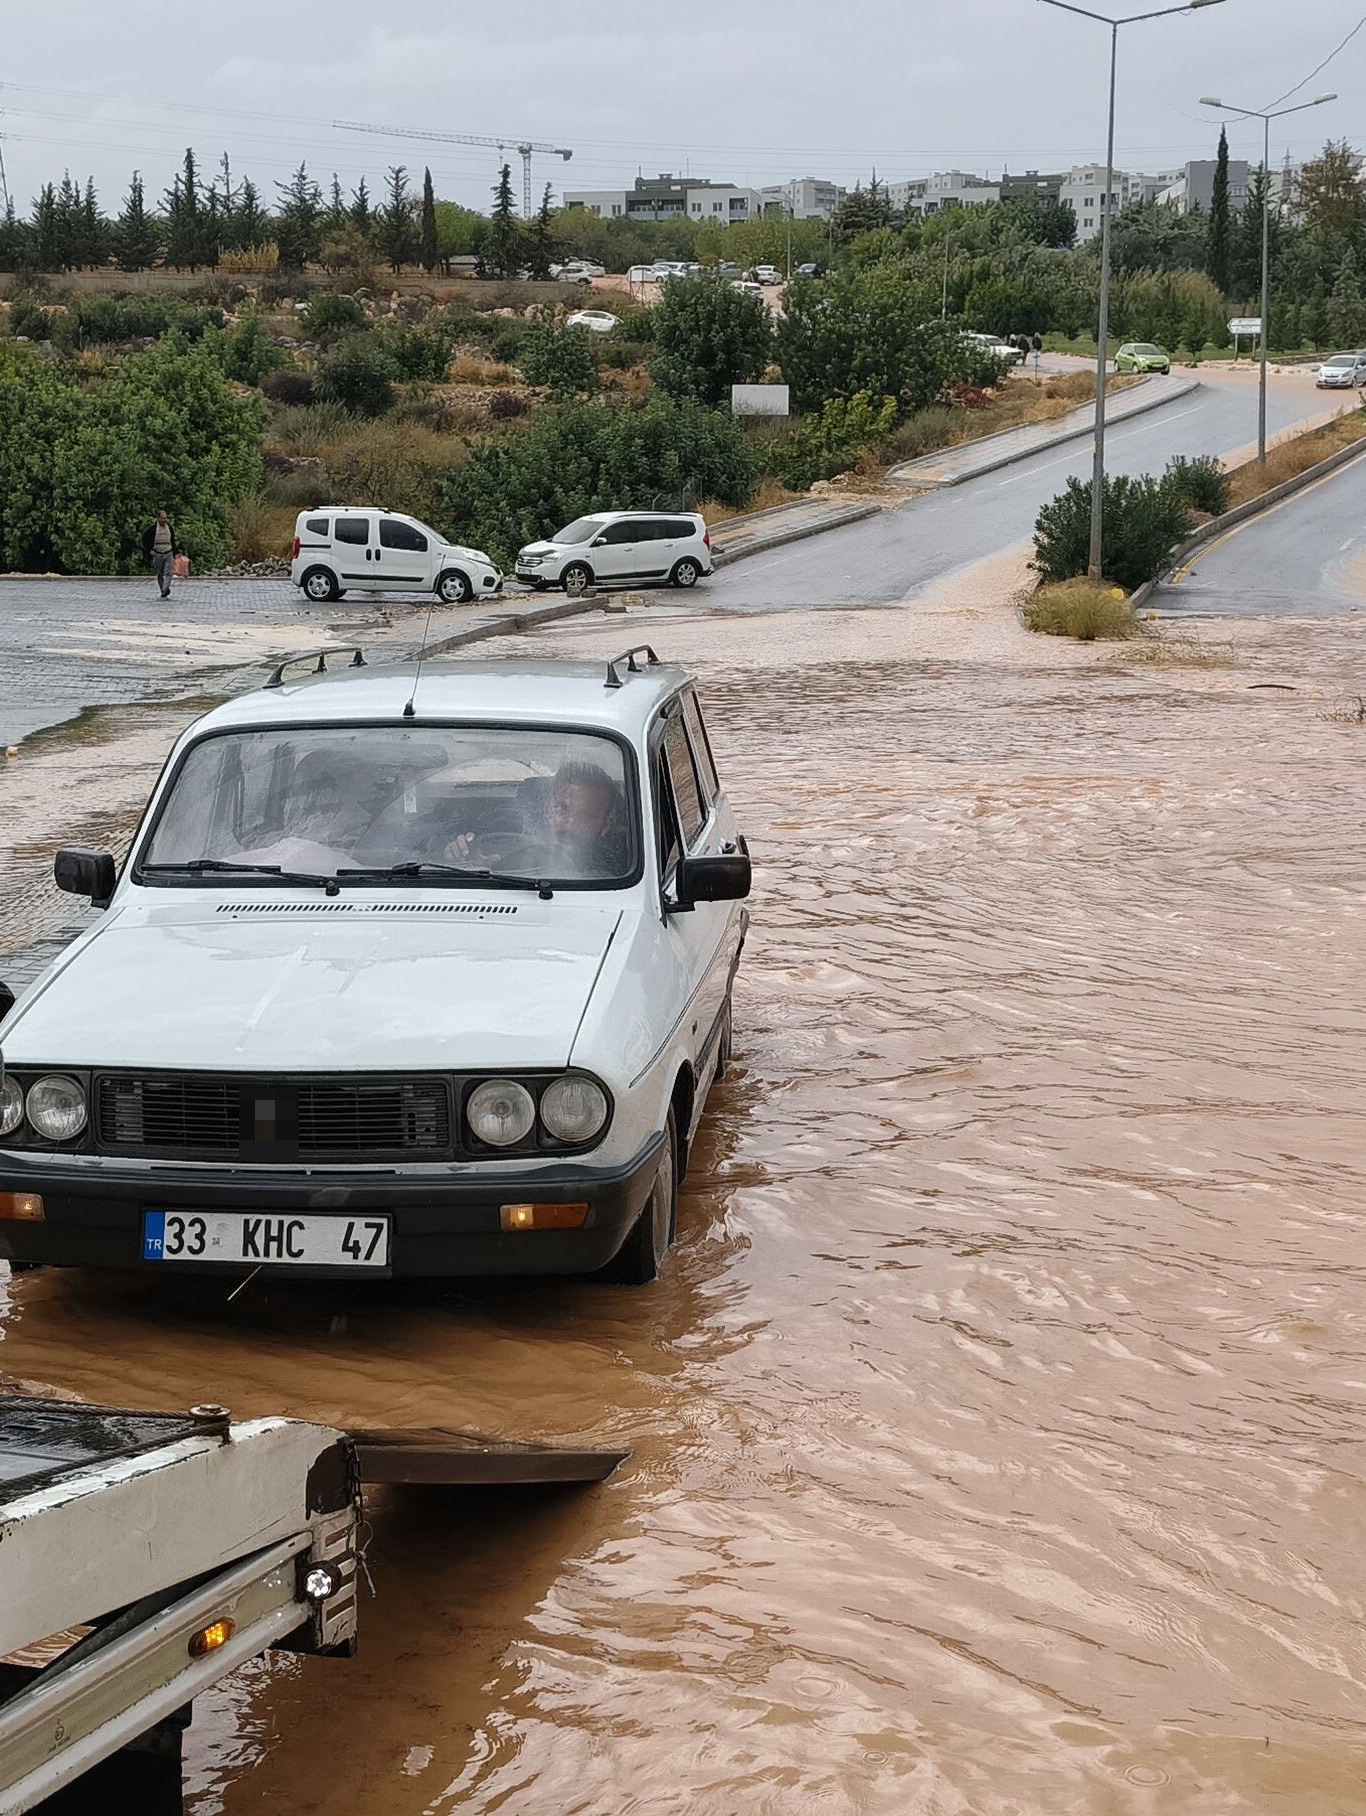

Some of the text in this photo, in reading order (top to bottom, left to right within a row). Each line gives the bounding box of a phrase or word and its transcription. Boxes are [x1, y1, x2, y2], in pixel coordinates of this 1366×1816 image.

[147, 1216, 385, 1261] TR 33 KHC 47
